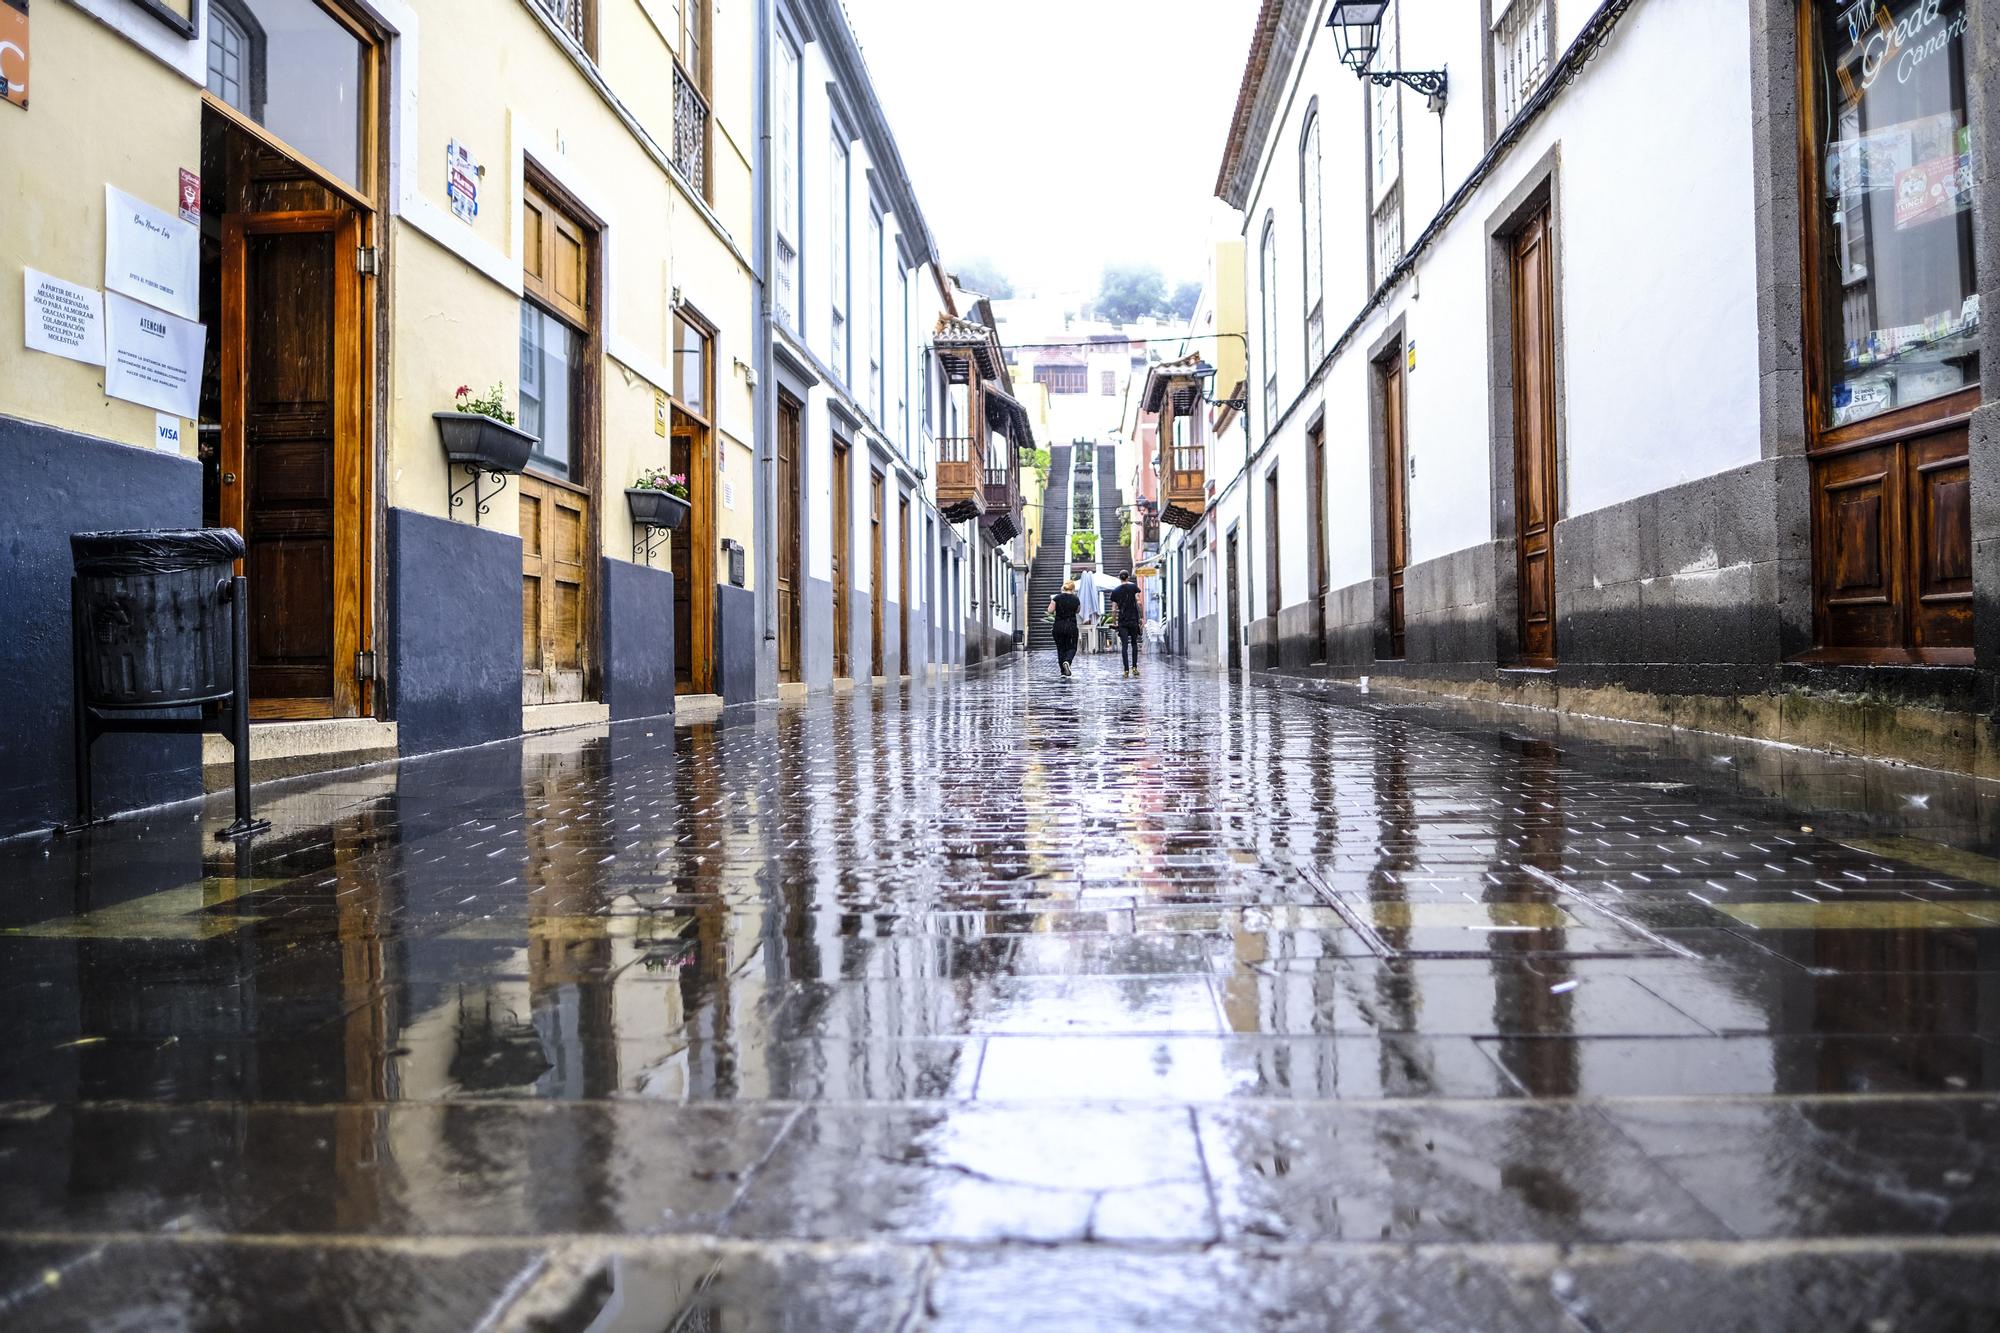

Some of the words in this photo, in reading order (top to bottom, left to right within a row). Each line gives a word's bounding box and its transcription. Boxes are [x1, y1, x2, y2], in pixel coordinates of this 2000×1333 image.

[45, 283, 65, 295] PARTIR
[73, 292, 80, 300] LA
[37, 289, 55, 300] MESAS
[55, 295, 90, 311] RESERVADAS
[42, 307, 66, 319] GRACIAS
[66, 314, 77, 323] POR
[48, 300, 62, 310] PARA
[63, 306, 94, 320] ALMORZAR
[44, 324, 73, 337] DISCULPEN
[73, 332, 85, 340] LAS
[48, 333, 79, 346] MOLESTIAS
[1854, 393, 1875, 403] SET
[158, 426, 178, 441] VISA
